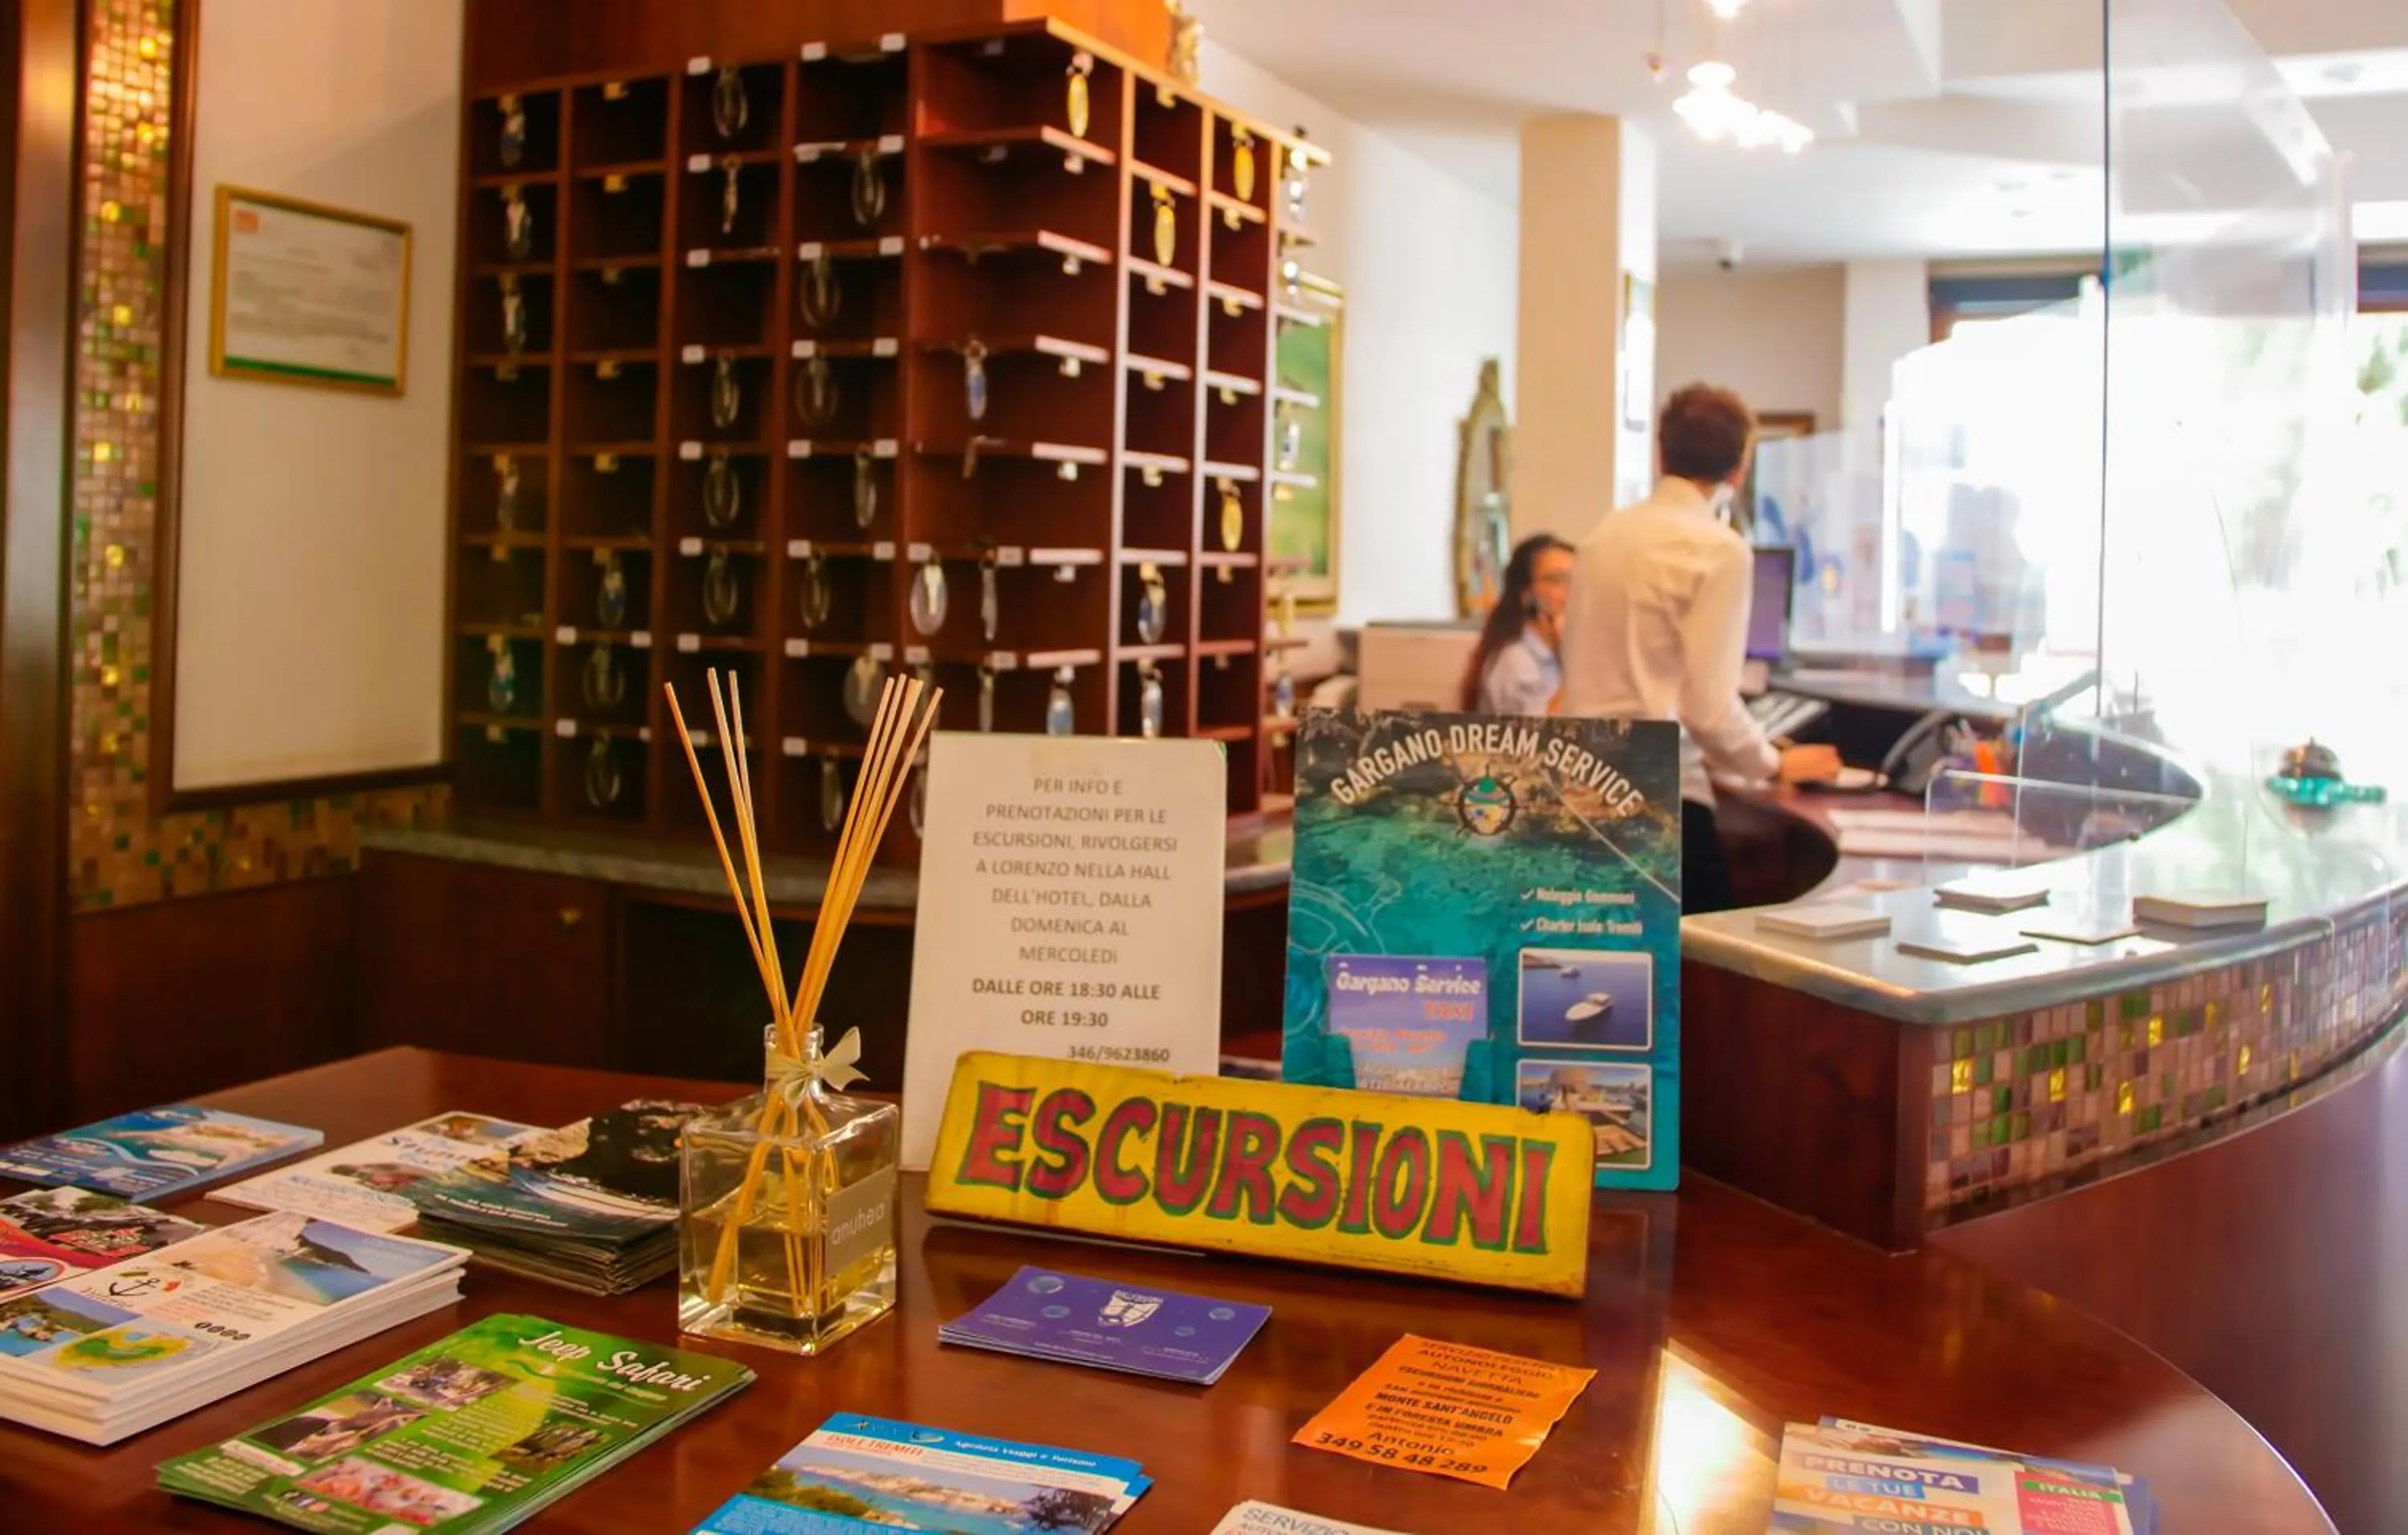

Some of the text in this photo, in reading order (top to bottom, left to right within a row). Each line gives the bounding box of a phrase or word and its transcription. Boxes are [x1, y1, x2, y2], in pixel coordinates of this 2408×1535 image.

[1330, 723, 1645, 817] GARGANO DREAM SERVICE
[1033, 777, 1123, 796] PER INFO E
[986, 804, 1167, 824] PRENOTAZIONI PER LE
[973, 832, 1178, 852] ESCURSIONI, RIVOLGERSI
[975, 861, 1171, 880] A LORENZO NELLA HALL
[1099, 892, 1152, 908] DALLA
[1011, 917, 1129, 936] DOMENICA AL
[972, 978, 1161, 1000] DALLE ORE 18:30 ALLE
[1021, 1010, 1108, 1028] ORE 19:30
[1068, 1044, 1170, 1063] 346/9623860
[955, 1081, 1556, 1254] ESCURSIONI
[518, 1330, 592, 1362] Jeep
[596, 1350, 712, 1392] Safari
[1375, 1392, 1421, 1407] MONTE
[1314, 1431, 1365, 1451] 349
[1366, 1443, 1399, 1460] 58
[1403, 1453, 1437, 1467] 48
[1438, 1459, 1489, 1474] 289
[1804, 1456, 1965, 1490] PRENOTA
[1871, 1480, 1918, 1498] TUE
[2038, 1483, 2103, 1501] ITALIA
[1807, 1488, 1971, 1526] VACANZE
[1862, 1517, 1923, 1535] CON
